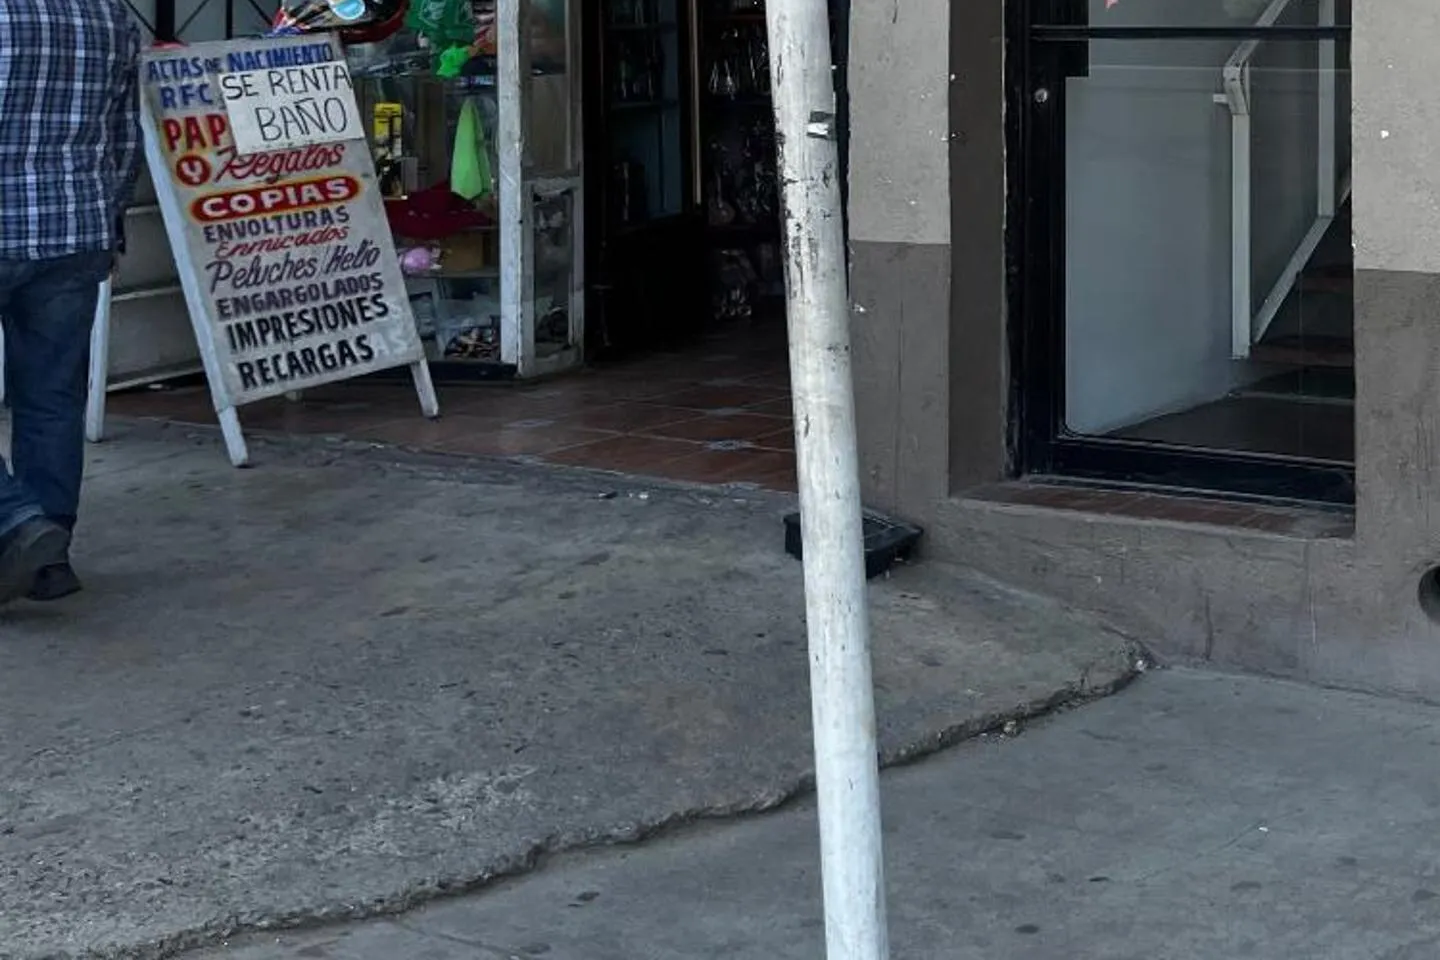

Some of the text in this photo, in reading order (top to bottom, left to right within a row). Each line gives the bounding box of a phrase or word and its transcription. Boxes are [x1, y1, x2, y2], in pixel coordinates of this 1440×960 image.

[148, 58, 205, 83] ACTAS
[227, 42, 334, 72] NACIMIENTO
[221, 74, 260, 101] SE
[268, 64, 354, 96] RENTA
[160, 83, 213, 110] RFC
[254, 96, 348, 142] BAÑO
[213, 142, 347, 185] Regalos
[201, 178, 350, 218] COPIAS
[203, 205, 350, 244] ENVOLTURAS
[215, 225, 351, 260] Enmicados
[215, 271, 385, 321] ENGARGOLADOS
[226, 292, 390, 354] IMPRESIONES
[236, 333, 375, 391] RECARGAS
